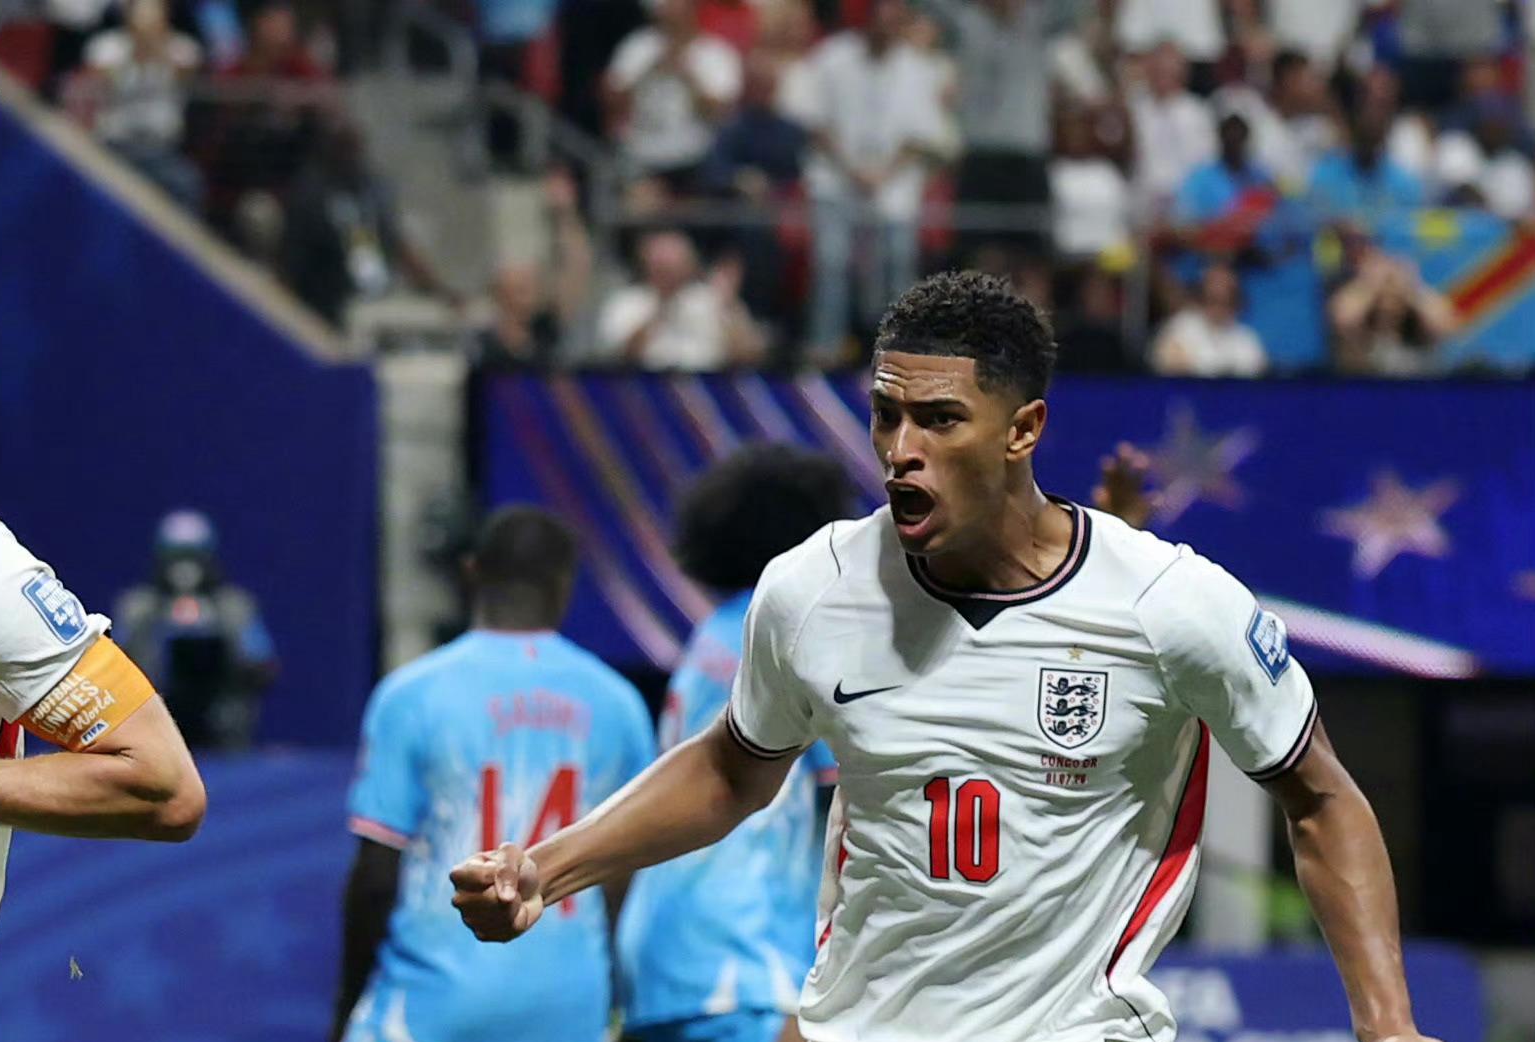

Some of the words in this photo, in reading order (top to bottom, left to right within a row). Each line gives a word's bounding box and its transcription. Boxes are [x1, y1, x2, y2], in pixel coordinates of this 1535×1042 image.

[39, 681, 99, 734] UNITES
[81, 722, 106, 742] FIFA
[1040, 754, 1079, 768] CONGO
[1082, 757, 1098, 768] DR
[480, 763, 579, 918] 14
[924, 776, 1001, 883] 10
